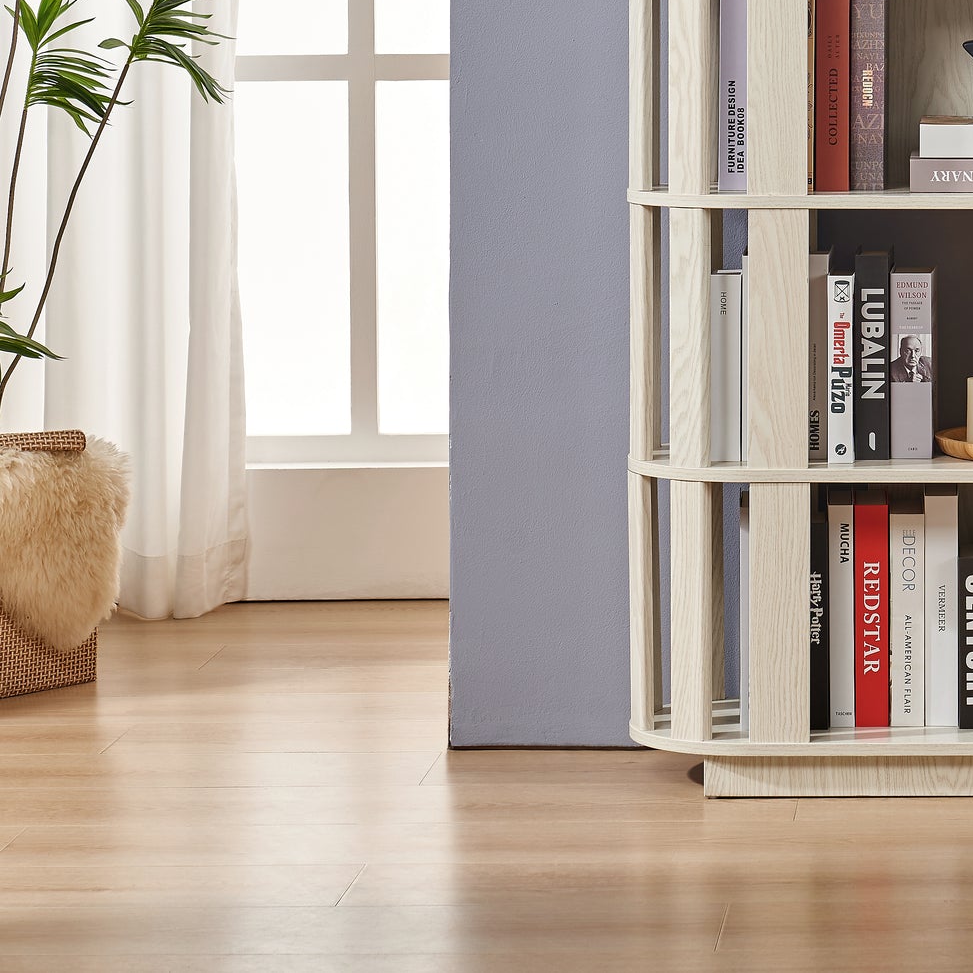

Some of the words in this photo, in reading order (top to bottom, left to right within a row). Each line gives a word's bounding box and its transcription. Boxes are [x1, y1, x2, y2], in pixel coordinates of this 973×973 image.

[829, 69, 838, 145] COLLECTED
[834, 322, 850, 365] Omerta
[861, 289, 885, 399] LUBALIN
[831, 366, 852, 413] Puzo
[810, 410, 820, 450] HOMES
[840, 523, 849, 563] MUCHA
[902, 536, 915, 591] DECOR
[810, 571, 822, 607] Harry
[810, 607, 824, 645] Potter
[864, 561, 880, 675] REDSTAR
[904, 615, 912, 684] ALL-AMERICAN
